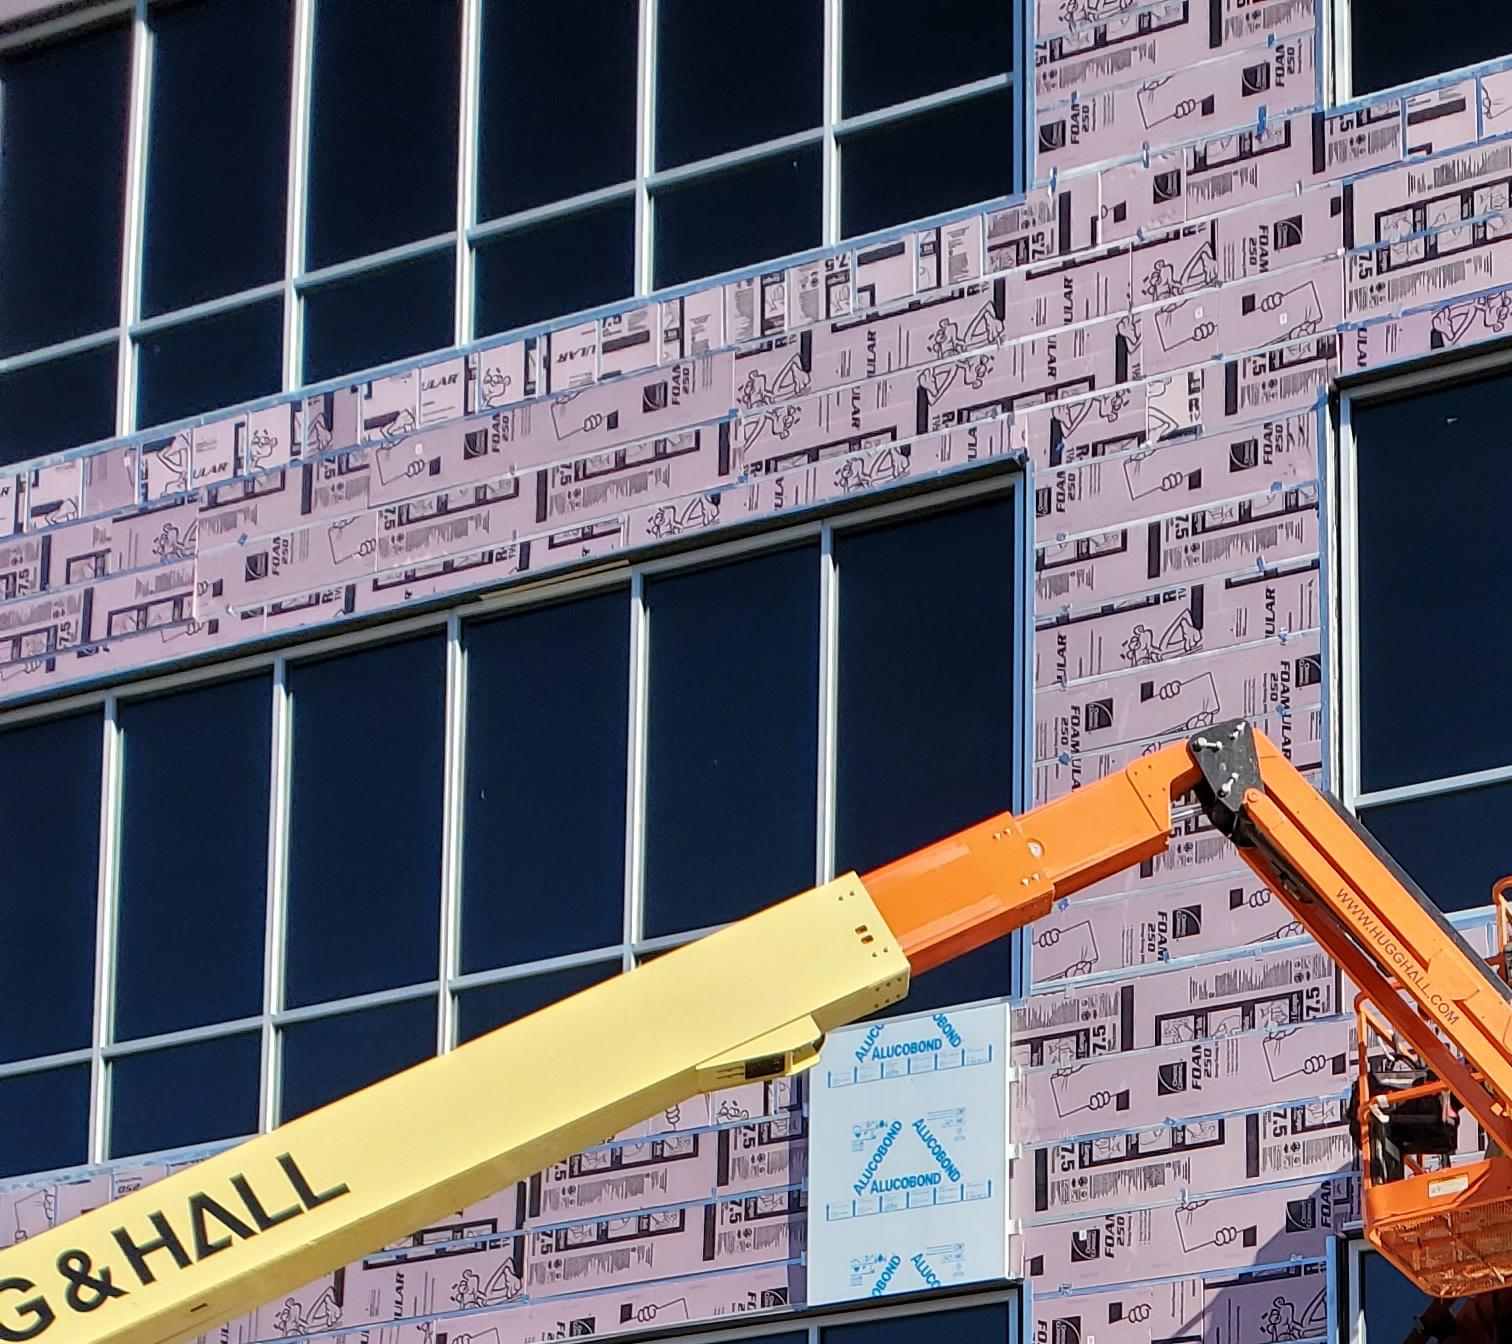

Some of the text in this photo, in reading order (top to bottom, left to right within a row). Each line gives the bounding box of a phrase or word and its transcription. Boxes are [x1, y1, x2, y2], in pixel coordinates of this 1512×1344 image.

[1335, 887, 1460, 1026] WWW.HUGGHALL.COM
[872, 1039, 942, 1060] ALUCOBOND
[854, 1121, 902, 1195] ALUCOBOND
[913, 1119, 960, 1182] ALUCOBOND
[868, 1173, 941, 1193] ALUCOBOND
